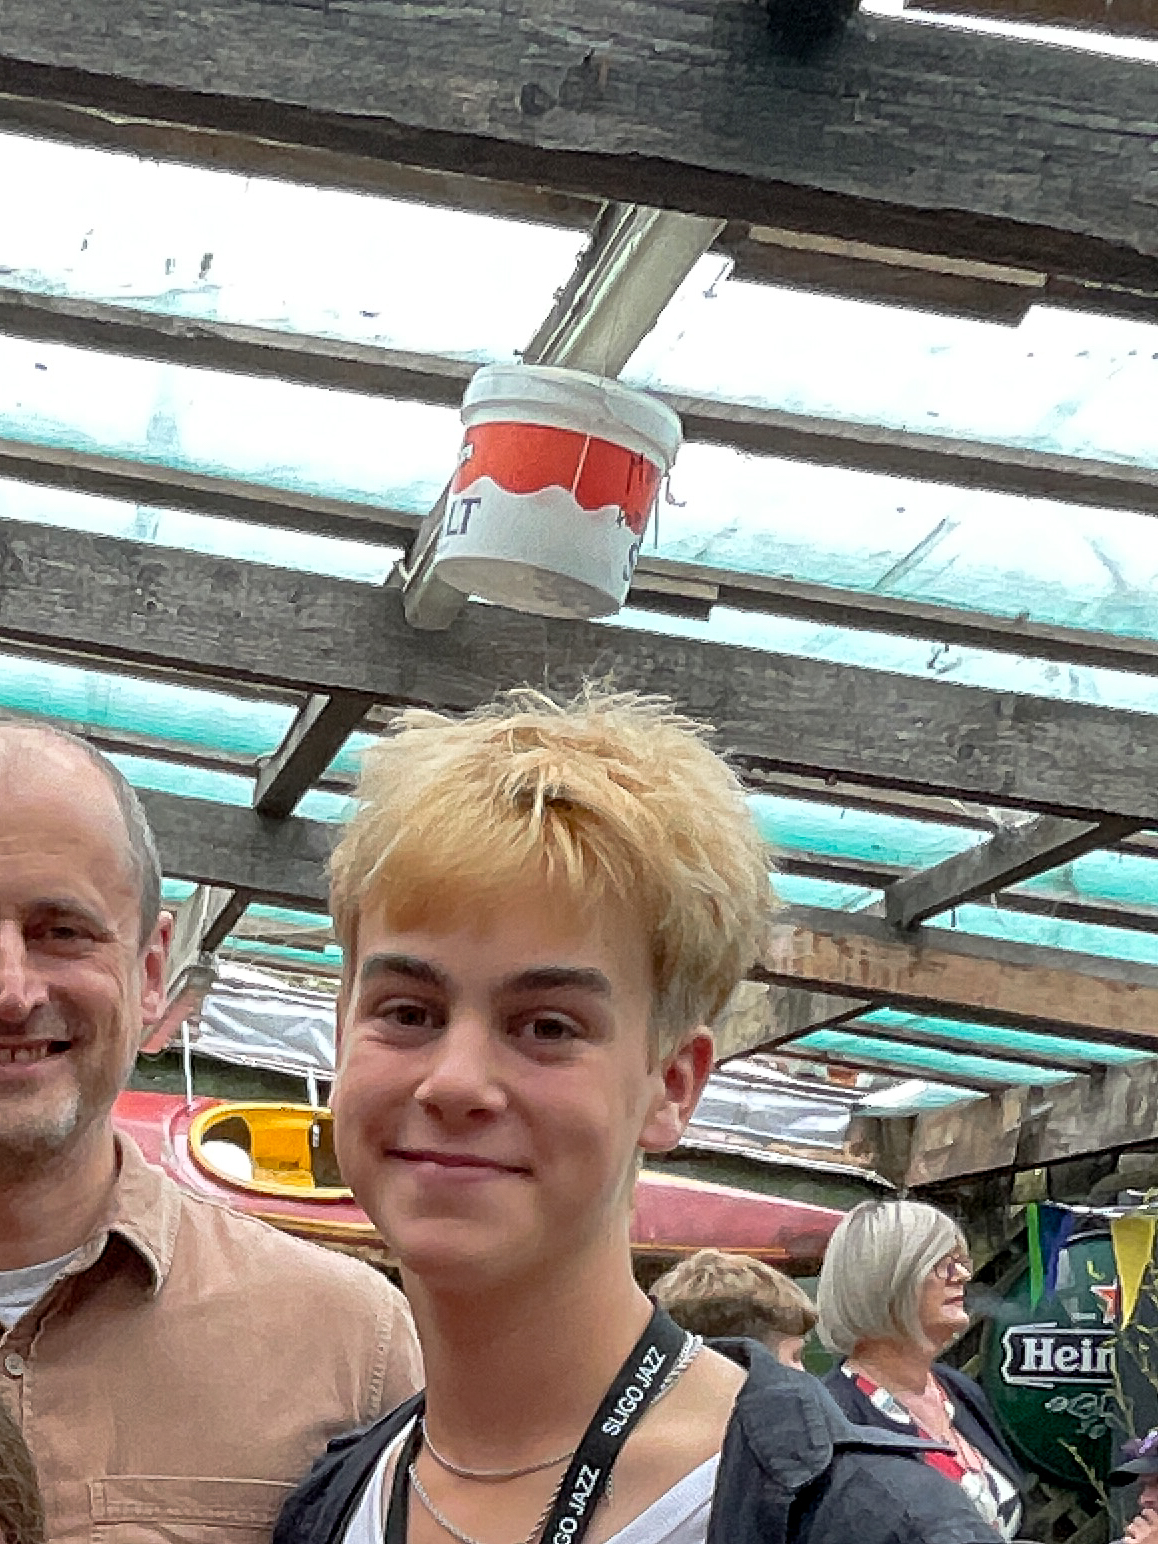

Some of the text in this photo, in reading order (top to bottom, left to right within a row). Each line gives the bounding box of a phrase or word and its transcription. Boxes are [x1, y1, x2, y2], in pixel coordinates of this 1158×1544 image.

[601, 1346, 667, 1436] SLIGO JAZZ
[568, 1464, 602, 1516] JAZZ
